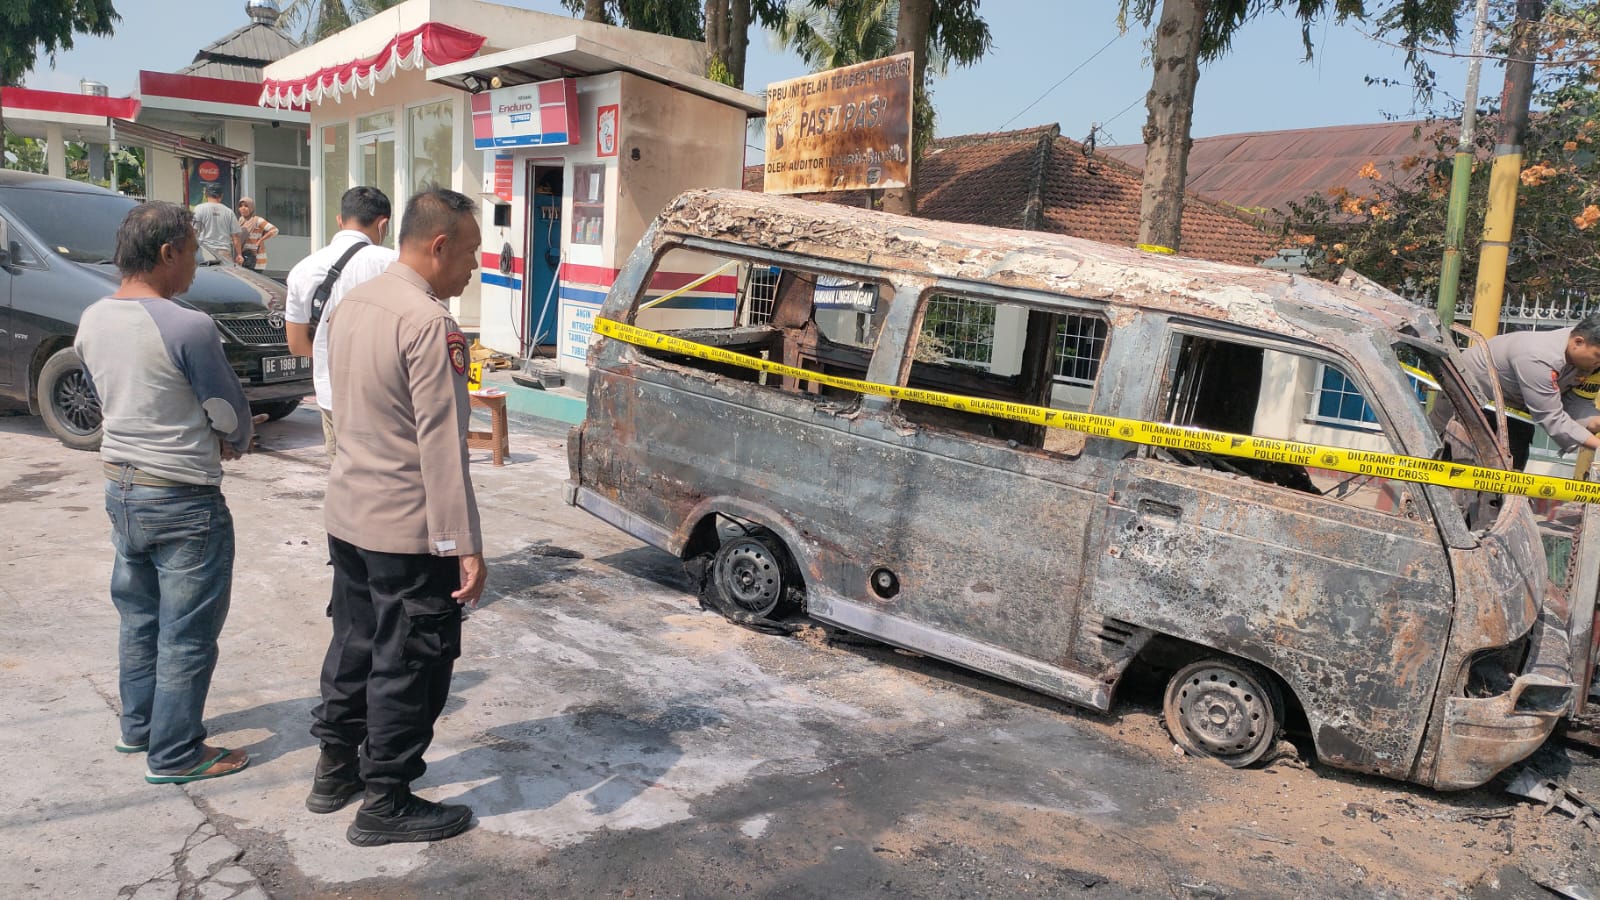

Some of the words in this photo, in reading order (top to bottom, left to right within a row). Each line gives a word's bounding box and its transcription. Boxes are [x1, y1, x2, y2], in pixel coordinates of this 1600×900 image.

[768, 87, 787, 101] SPBU
[789, 86, 800, 99] INI
[801, 78, 828, 96] TELAH
[499, 103, 532, 113] Enduro
[800, 105, 843, 138] PASTI
[767, 162, 786, 174] OLEH
[788, 157, 824, 171] AUDITOR
[266, 359, 276, 373] BE
[904, 389, 925, 400] GARIS
[926, 392, 949, 403] POLISI
[970, 399, 1004, 412] DILARANG
[1006, 404, 1041, 417] MELINTAS
[1062, 412, 1086, 423] GARIS
[1088, 415, 1116, 427] POLISI
[1064, 422, 1092, 434] POLICE
[1093, 427, 1111, 436] LINE
[1141, 423, 1182, 437] DILARANG
[1184, 429, 1226, 443] MELINTAS
[1151, 435, 1162, 444] DO
[1165, 437, 1181, 447] NOT
[1183, 440, 1213, 451] CROSS
[1252, 439, 1281, 450] GARIS
[1284, 443, 1317, 455] POLISI
[1254, 449, 1286, 462] POLICE
[1289, 454, 1311, 465] LINE
[1347, 451, 1396, 466] DILARANG
[1398, 458, 1445, 472] MELINTAS
[1360, 463, 1372, 473] DO
[1376, 466, 1395, 476] NOT
[1398, 469, 1430, 481] CROSS
[1472, 468, 1501, 481] GARIS
[1504, 473, 1535, 486] POLISI
[1474, 479, 1505, 492] POLICE
[1508, 484, 1529, 495] LINE
[1564, 481, 1600, 495] DILARAN
[1573, 494, 1588, 502] DO
[1589, 496, 1600, 504] NO
